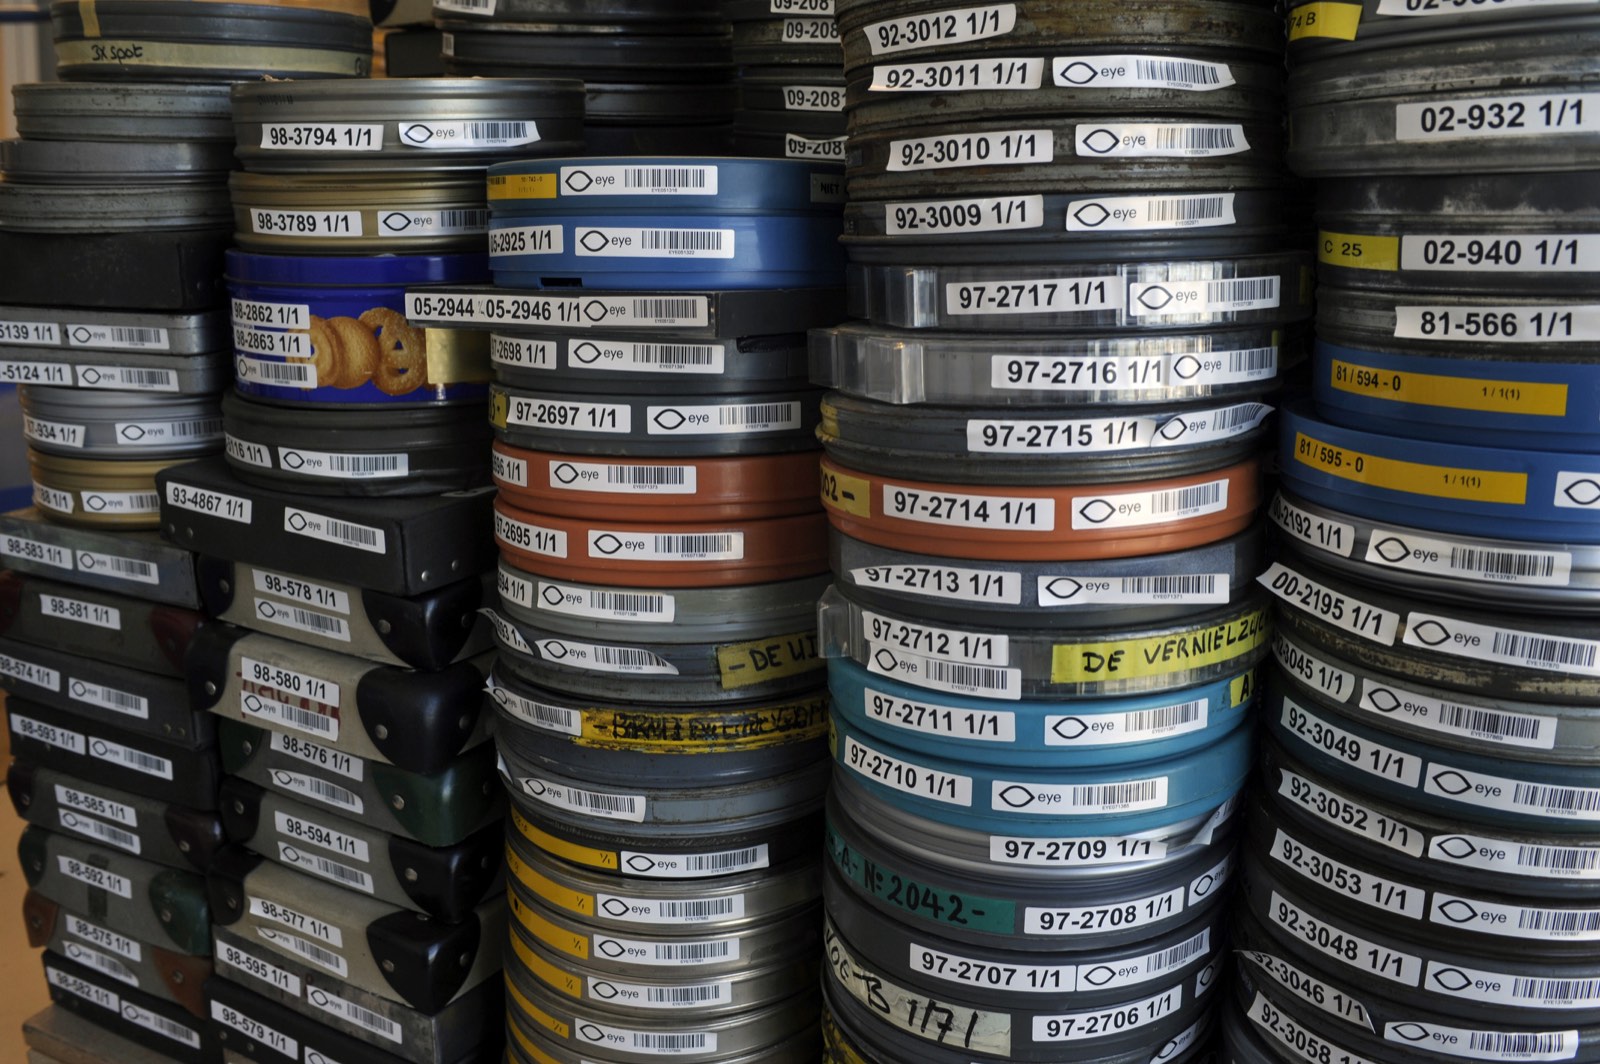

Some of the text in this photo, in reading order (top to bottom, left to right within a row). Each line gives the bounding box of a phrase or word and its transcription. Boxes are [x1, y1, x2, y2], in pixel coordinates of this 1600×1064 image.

[879, 10, 999, 48] 92-3012 1/1
[1306, 12, 1316, 26] B
[111, 44, 143, 65] spot
[885, 62, 1027, 88] 92-3011 1/1
[1421, 99, 1583, 133] 02-932 1/1
[270, 126, 372, 147] 98-3794 1/1
[436, 128, 455, 138] eye
[1122, 135, 1146, 148] eye
[902, 134, 1036, 166] 92-3010 1/1
[820, 182, 840, 195] NIET
[257, 212, 350, 233] 98-3789 1/1
[414, 216, 432, 226] eye
[895, 200, 1027, 229] 92-3009 1/1
[489, 230, 552, 253] 05-2925 1/1
[612, 236, 632, 247] eye
[1324, 240, 1363, 257] C 25
[1424, 239, 1578, 266] 02-940 1/1
[959, 281, 1106, 309] 97-2717 1/1
[1176, 289, 1198, 302] eye
[234, 302, 299, 324] 98-2862 1/1
[414, 297, 581, 322] 05-2944 05-2946 1/1
[1421, 311, 1572, 337] 81-566 1/1
[236, 330, 300, 353] 98-2863 1/1
[526, 343, 546, 365] 1/1
[1007, 360, 1162, 384] 97-2716 1/1
[1336, 365, 1348, 381] 81
[1357, 370, 1379, 388] 594
[1392, 375, 1401, 391] 0
[1482, 386, 1488, 397] 1
[1499, 387, 1520, 400] 1(1)
[516, 402, 579, 427] 97-2697
[588, 407, 617, 428] 1/1
[688, 413, 710, 425] eye
[147, 428, 164, 437] eye
[982, 421, 1138, 448] 97-2715 1/1
[1300, 438, 1311, 455] 81
[1320, 447, 1342, 468] 595
[1355, 457, 1363, 473] 0
[173, 488, 243, 518] 93-4867 1/1
[894, 491, 1037, 525] 97-2714 1/1
[1118, 501, 1141, 516] eye
[495, 514, 557, 553] 97-2695 1/1
[1316, 521, 1342, 549] 1/1
[7, 538, 62, 563] 98-583 1/1
[265, 574, 336, 609] 98-578 1/1
[865, 567, 1004, 597] 97-2713 1/1
[1086, 579, 1110, 592] eye
[50, 599, 110, 623] 98-581 1/1
[565, 594, 583, 604] eye
[1272, 571, 1383, 637] 00-2195 1/1
[872, 617, 993, 660] 97-2712 1/1
[1454, 632, 1481, 647] eye
[750, 647, 782, 671] DE
[1083, 650, 1126, 673] DE
[1526, 660, 1559, 670] EYE137870
[253, 664, 326, 700] 98-580 1/1
[1318, 666, 1343, 696] 1/1
[264, 704, 276, 713] eye
[873, 697, 1000, 736] 97-2711 1/1
[20, 719, 75, 748] 98-593 1/1
[1288, 707, 1405, 778] 92-3049 1/1
[282, 734, 350, 773] 98-576 1/1
[850, 744, 957, 799] 97-2710 1/1
[1475, 783, 1502, 797] eye
[65, 790, 125, 820] 98-585 1/1
[1290, 776, 1408, 848] 92-3052 1/1
[286, 818, 355, 855] 98-594 1/1
[1004, 840, 1152, 860] 97-2709 1/1
[68, 860, 122, 892] 98-592 1/1
[657, 859, 677, 870] eye
[1283, 839, 1407, 910] 92-3053 1/1
[261, 901, 329, 940] 98-577 1/1
[1040, 895, 1173, 931] 97-2708 1/1
[1278, 902, 1402, 977] 92-3048 1/1
[226, 948, 289, 989] 98-595 1/1
[921, 951, 1060, 988] 97-2707 1/1
[1251, 951, 1365, 1022] 92-3046 1/1
[1047, 993, 1172, 1037] 97-2706 1/1
[222, 1008, 287, 1051] 98-579 1/1
[1261, 1003, 1332, 1060] 92-3058
[1433, 1032, 1458, 1045] eye
